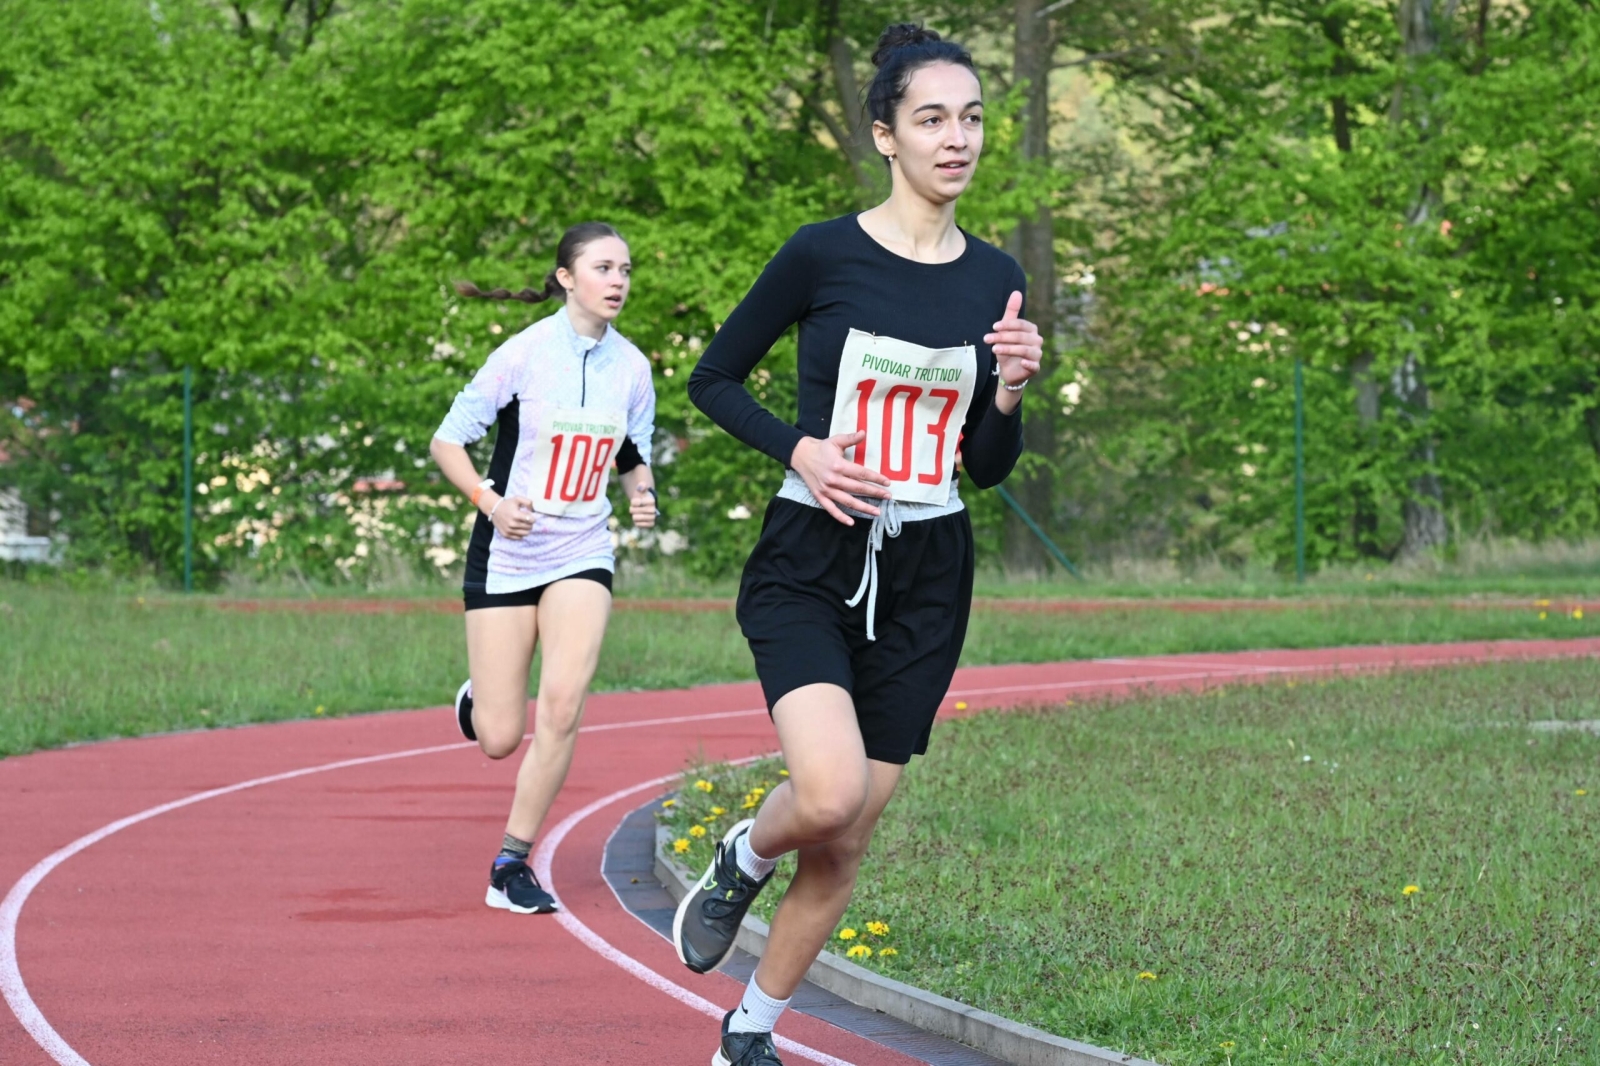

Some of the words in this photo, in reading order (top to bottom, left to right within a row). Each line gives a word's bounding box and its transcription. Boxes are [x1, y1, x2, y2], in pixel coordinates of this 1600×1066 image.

[862, 353, 911, 378] PIVOVAR
[914, 366, 963, 382] TRUTNOV
[552, 420, 583, 433] PIVOVAR
[585, 423, 617, 435] TRUTNOV
[853, 378, 960, 486] 103
[543, 433, 615, 503] 108
